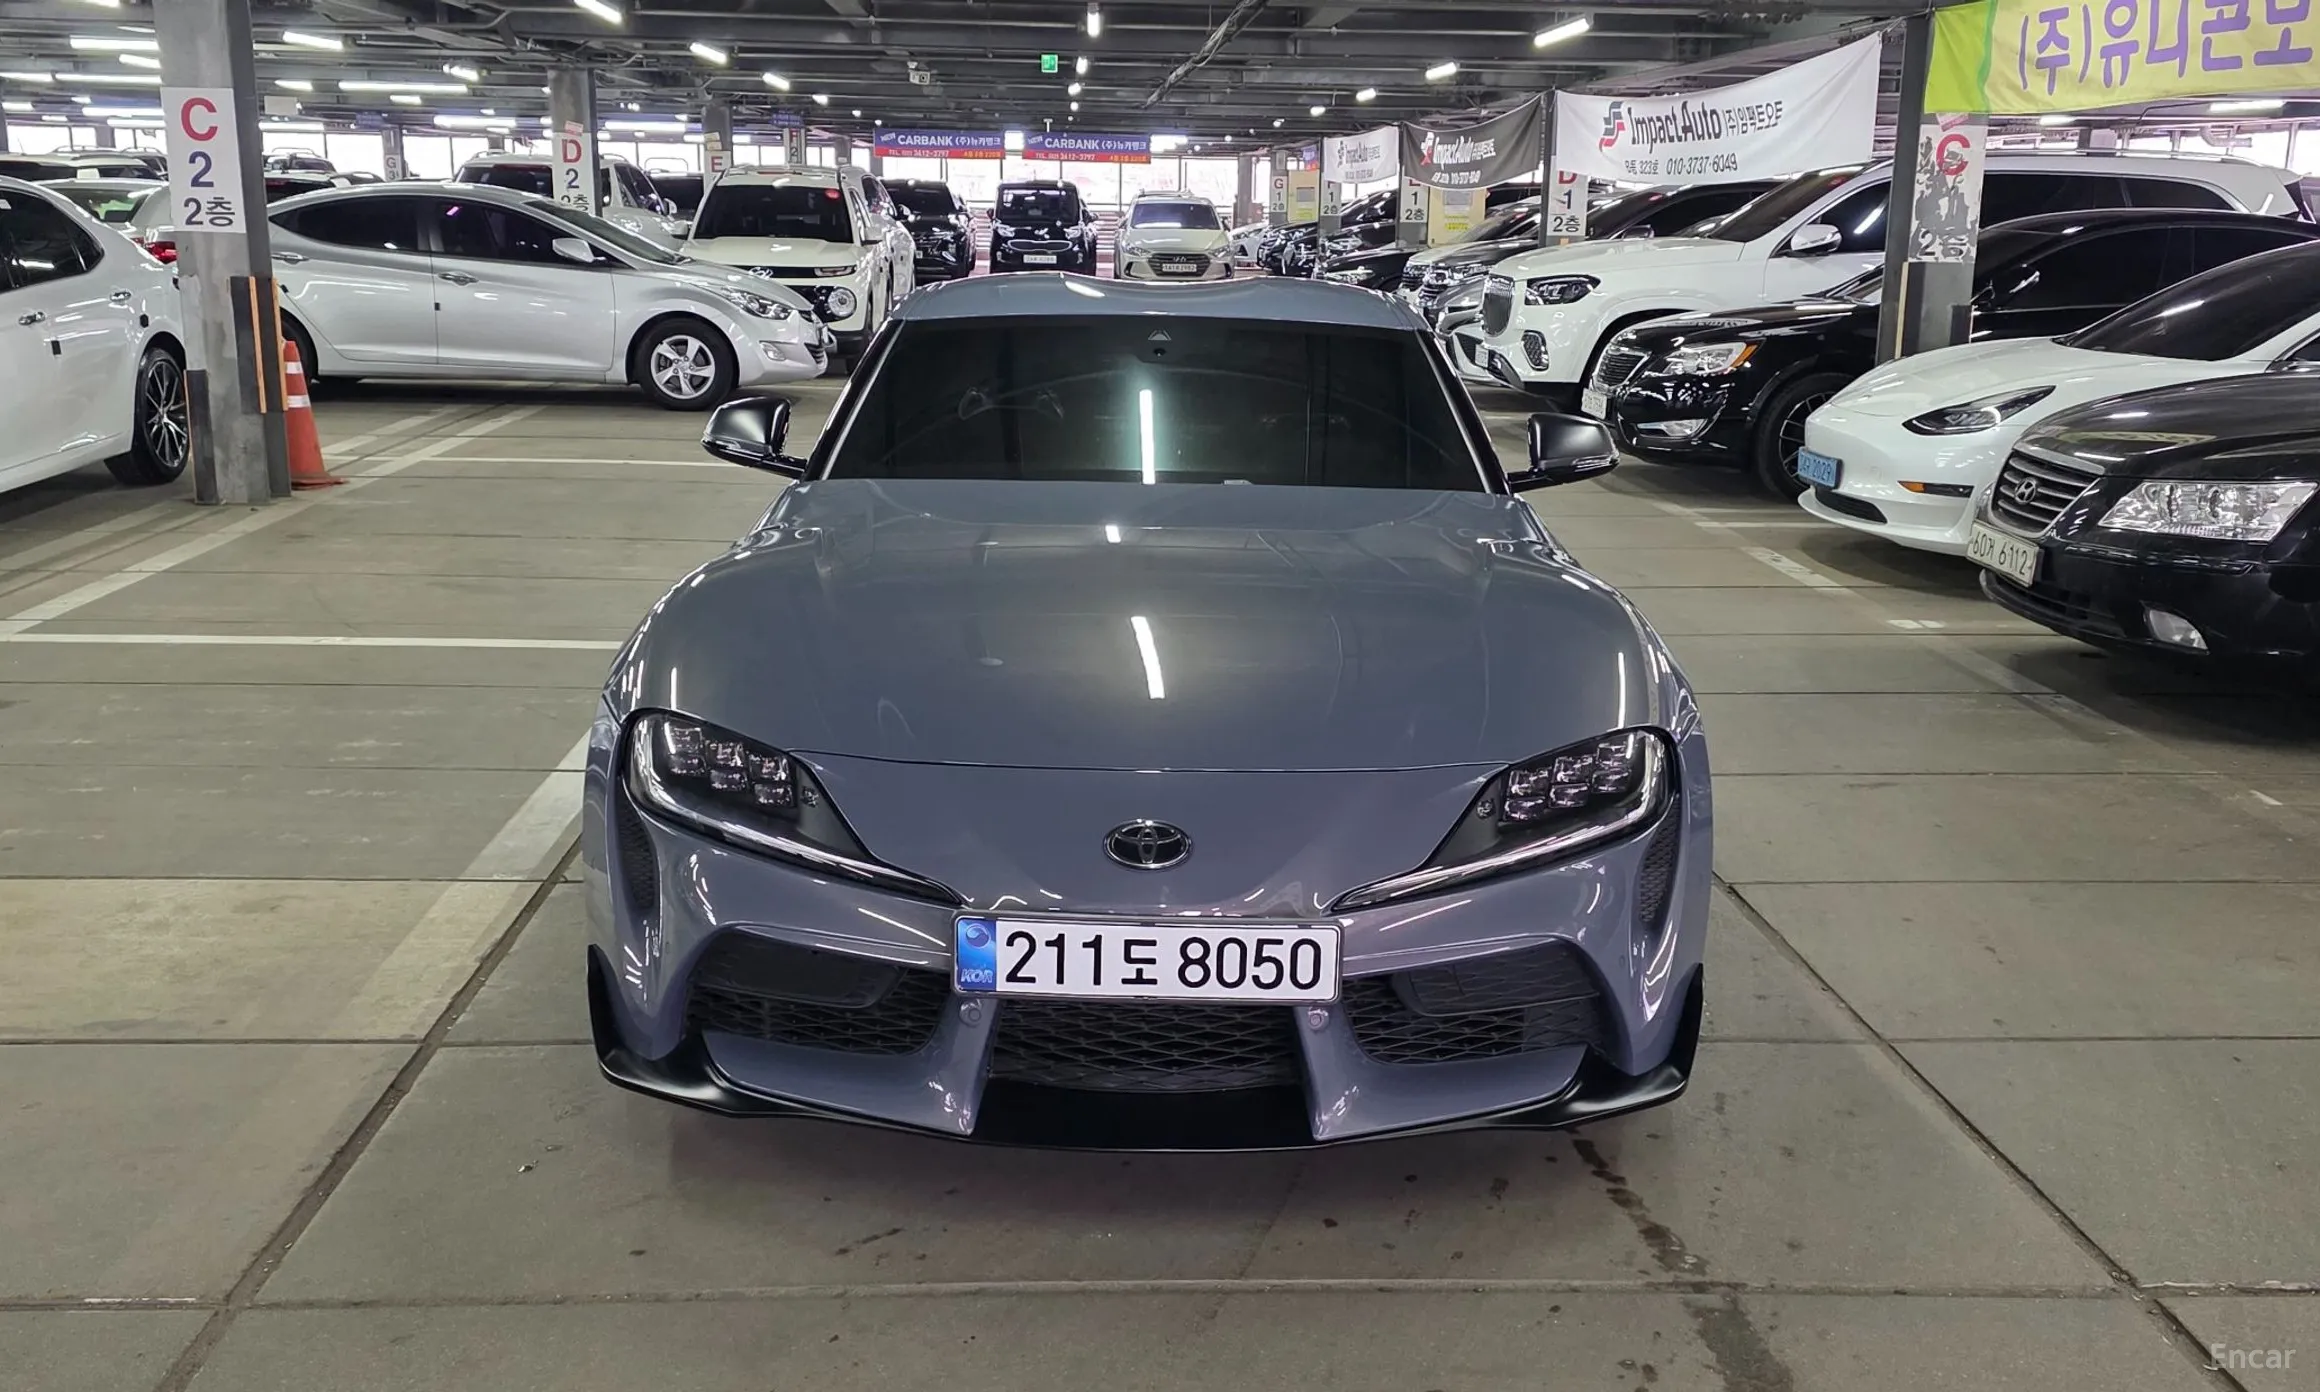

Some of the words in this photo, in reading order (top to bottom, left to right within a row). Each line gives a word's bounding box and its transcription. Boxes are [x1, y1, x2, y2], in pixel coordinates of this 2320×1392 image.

[181, 97, 218, 142] C
[897, 135, 953, 147] CARBANK
[1044, 138, 1100, 150] CARBANK
[561, 139, 582, 163] D
[1936, 134, 1971, 176] C
[188, 151, 214, 188] 2
[711, 156, 723, 172] E
[565, 168, 580, 189] 2
[1274, 178, 1284, 189] G
[1276, 191, 1282, 202] 1
[1329, 191, 1334, 202] 1
[1411, 191, 1418, 205] 1
[1563, 189, 1572, 210] 1
[184, 196, 236, 227] 2층
[1405, 208, 1425, 220] 2층
[1553, 215, 1581, 233] 2층
[1999, 541, 2027, 575] 6112
[1005, 930, 1158, 986] 211도
[1177, 936, 1322, 990] 8050
[960, 967, 994, 984] KOR
